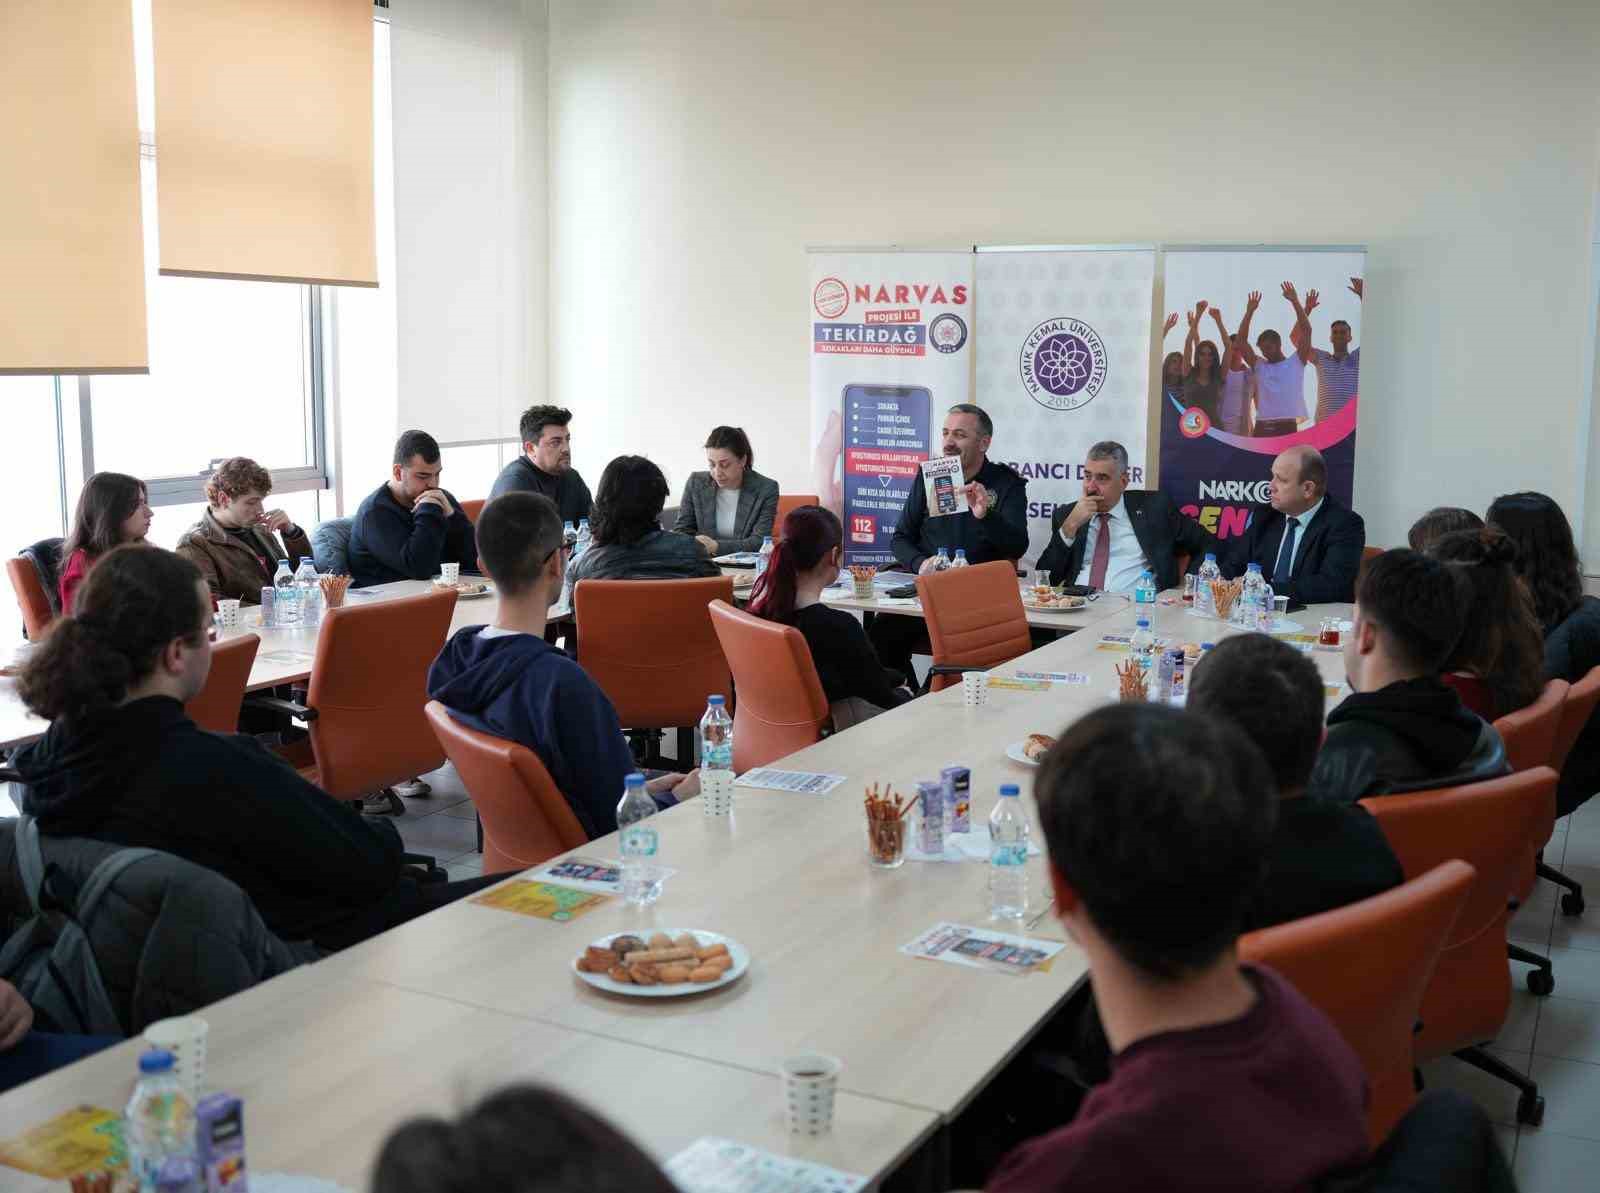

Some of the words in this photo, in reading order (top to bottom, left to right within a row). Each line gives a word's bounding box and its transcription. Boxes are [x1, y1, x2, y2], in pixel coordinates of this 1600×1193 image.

[855, 285, 967, 304] NARVAS
[822, 325, 917, 343] TEKİRDAĞ
[1028, 320, 1066, 348] KEMAL
[1023, 352, 1040, 393] NAMIK
[1047, 395, 1078, 408] 2006
[1008, 462, 1070, 480] BANCI
[854, 518, 872, 532] 112
[1180, 504, 1254, 539] EN
